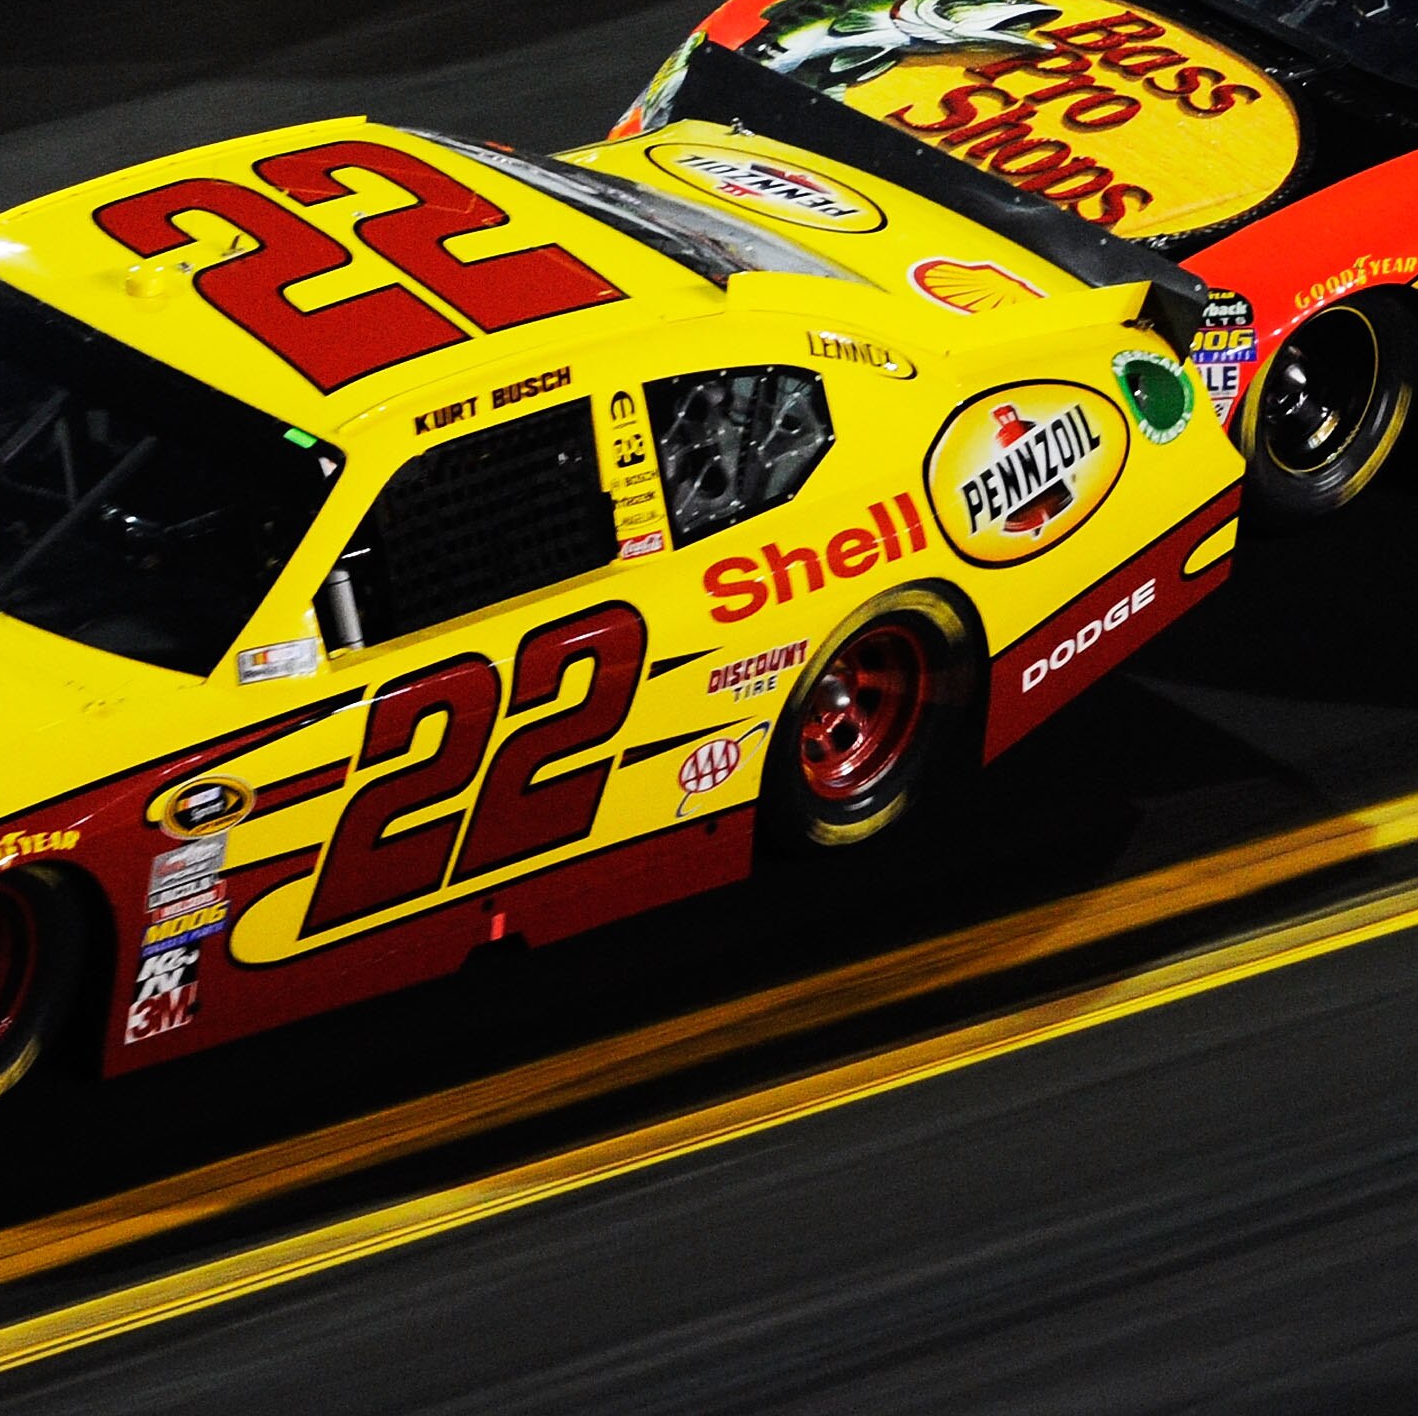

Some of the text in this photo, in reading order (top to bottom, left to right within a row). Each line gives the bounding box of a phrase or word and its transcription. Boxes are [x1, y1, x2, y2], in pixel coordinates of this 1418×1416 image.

[966, 44, 1143, 133] Pro
[1037, 10, 1263, 119] Bass
[676, 153, 861, 219] PENNZOIL
[886, 84, 1155, 227] Shops
[92, 141, 631, 396] 22
[1294, 254, 1418, 310] GOODYEAR
[1205, 316, 1247, 327] LTS
[415, 365, 572, 436] KURT BUSCH
[961, 403, 1101, 535] PENNZOIL
[703, 492, 928, 625] Shell
[707, 639, 810, 694] DISCOUNT
[1021, 578, 1157, 693] DODGE
[733, 674, 778, 703] TIRE
[298, 599, 648, 942] 22
[145, 900, 231, 945] MOOG
[129, 981, 199, 1040] 3M
